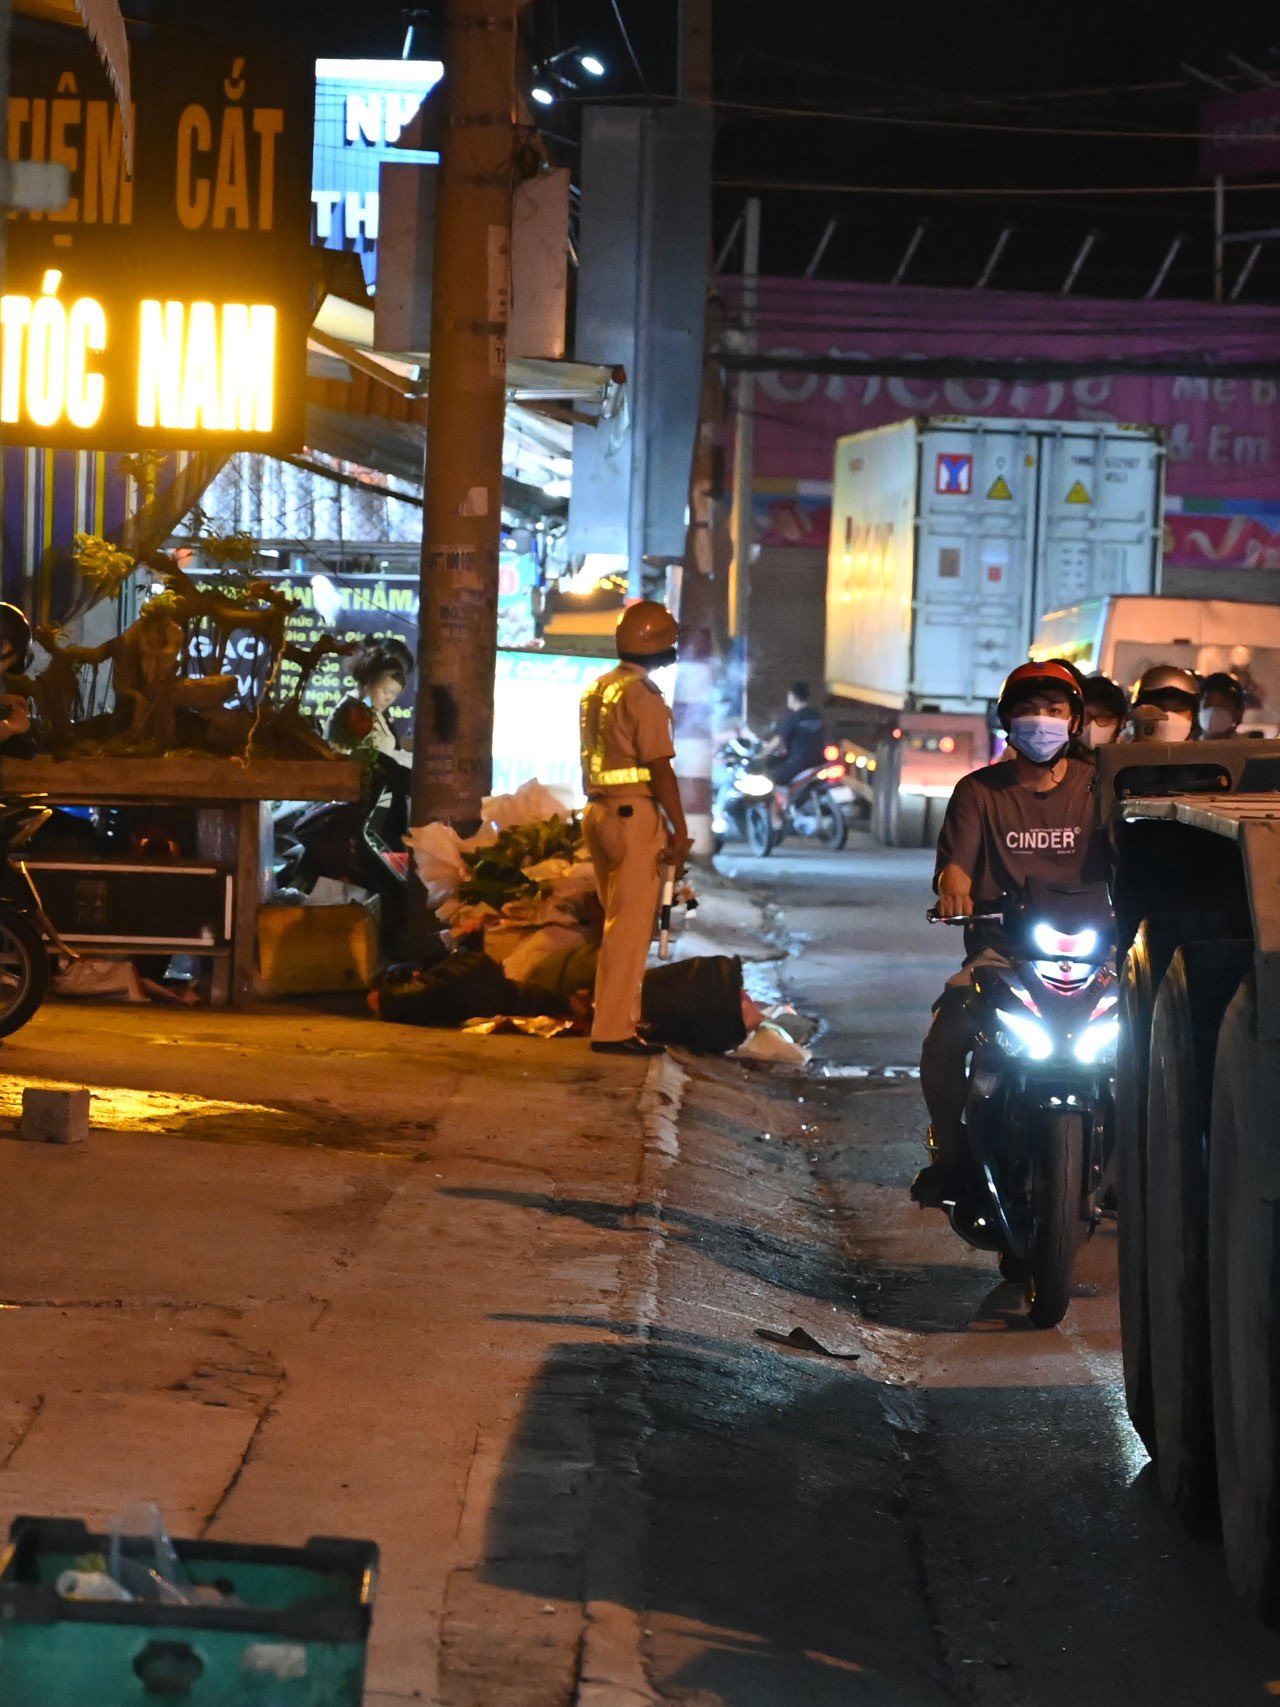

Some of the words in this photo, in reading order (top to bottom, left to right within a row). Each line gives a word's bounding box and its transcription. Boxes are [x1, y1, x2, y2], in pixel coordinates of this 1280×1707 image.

[6, 71, 136, 248] TIỆM
[176, 57, 285, 231] CẮT
[0, 269, 107, 429] TÓC
[137, 299, 277, 433] NAM
[1006, 831, 1075, 849] CINDER
